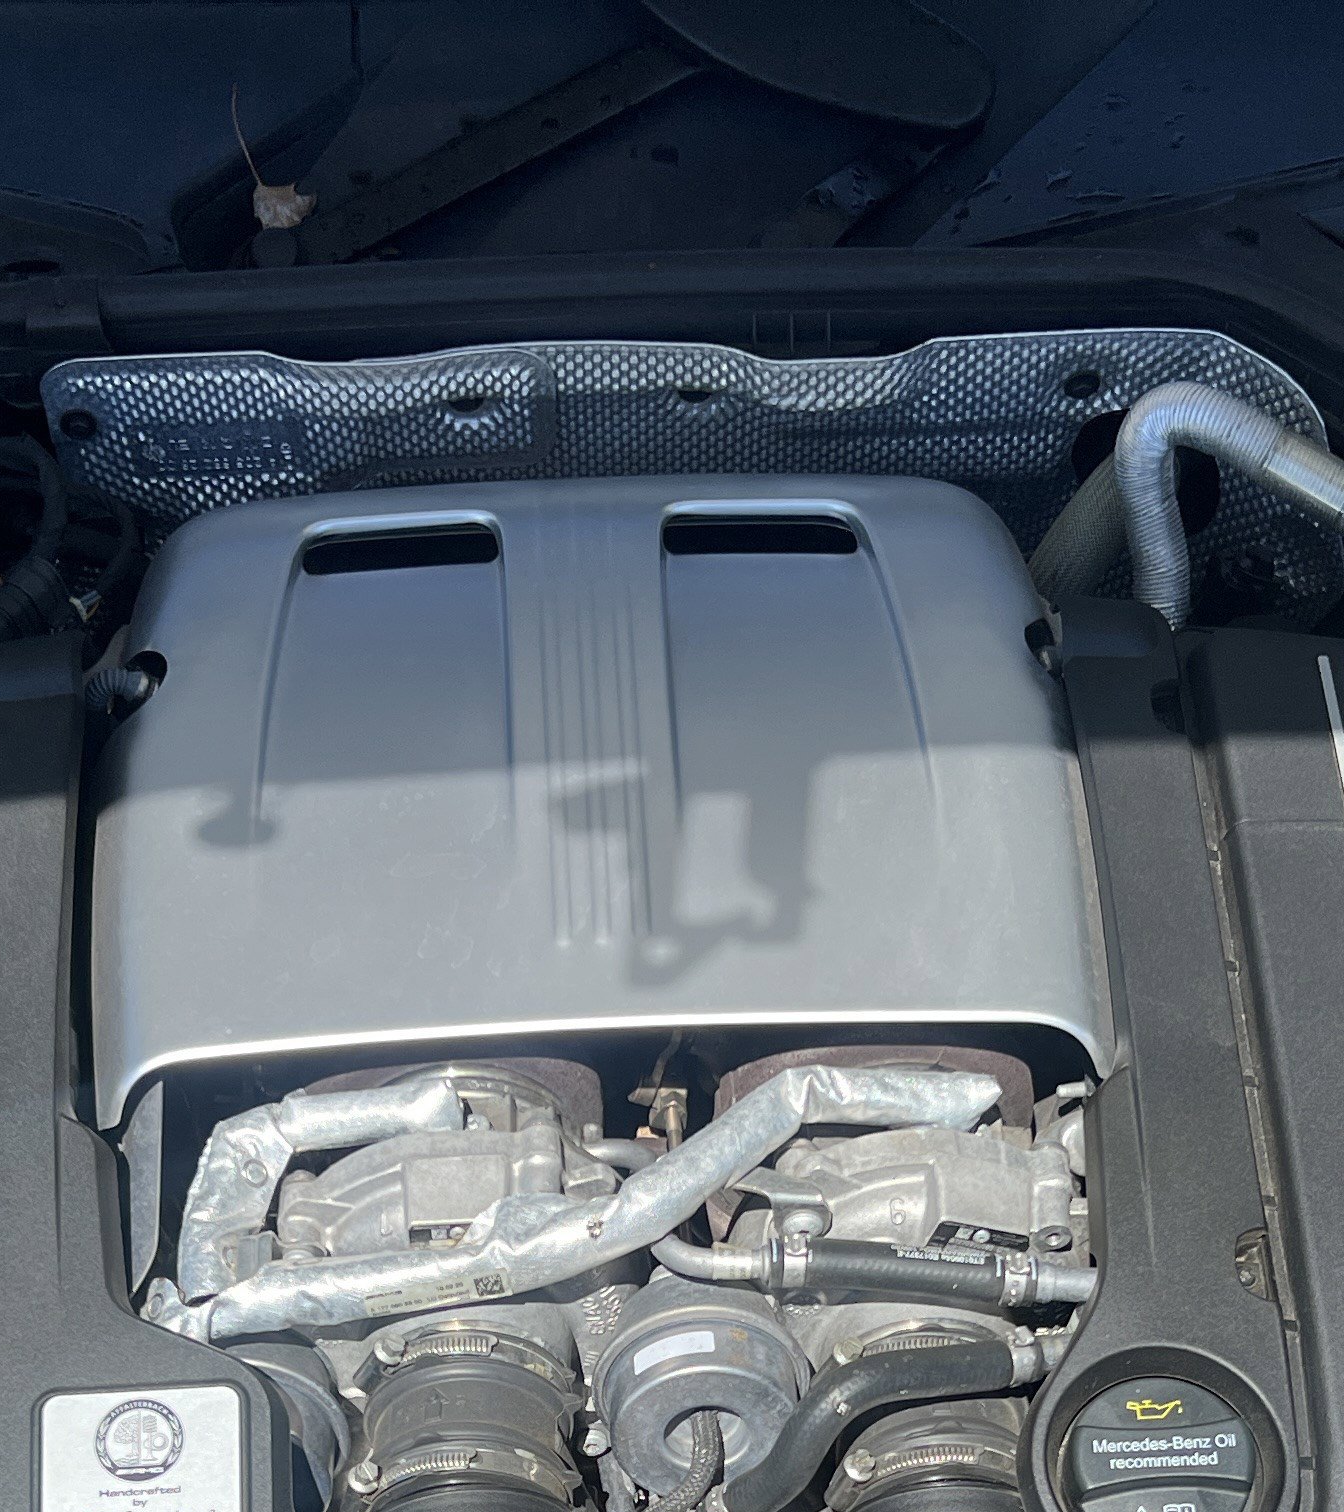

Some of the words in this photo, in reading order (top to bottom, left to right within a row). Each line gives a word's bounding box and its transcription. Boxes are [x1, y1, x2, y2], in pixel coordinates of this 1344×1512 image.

[1092, 1434, 1212, 1454] Mercedes-Benz
[1214, 1433, 1237, 1448] Oil
[1109, 1451, 1219, 1470] recommended
[98, 1485, 182, 1498] Handcrafted
[132, 1498, 147, 1508] by
